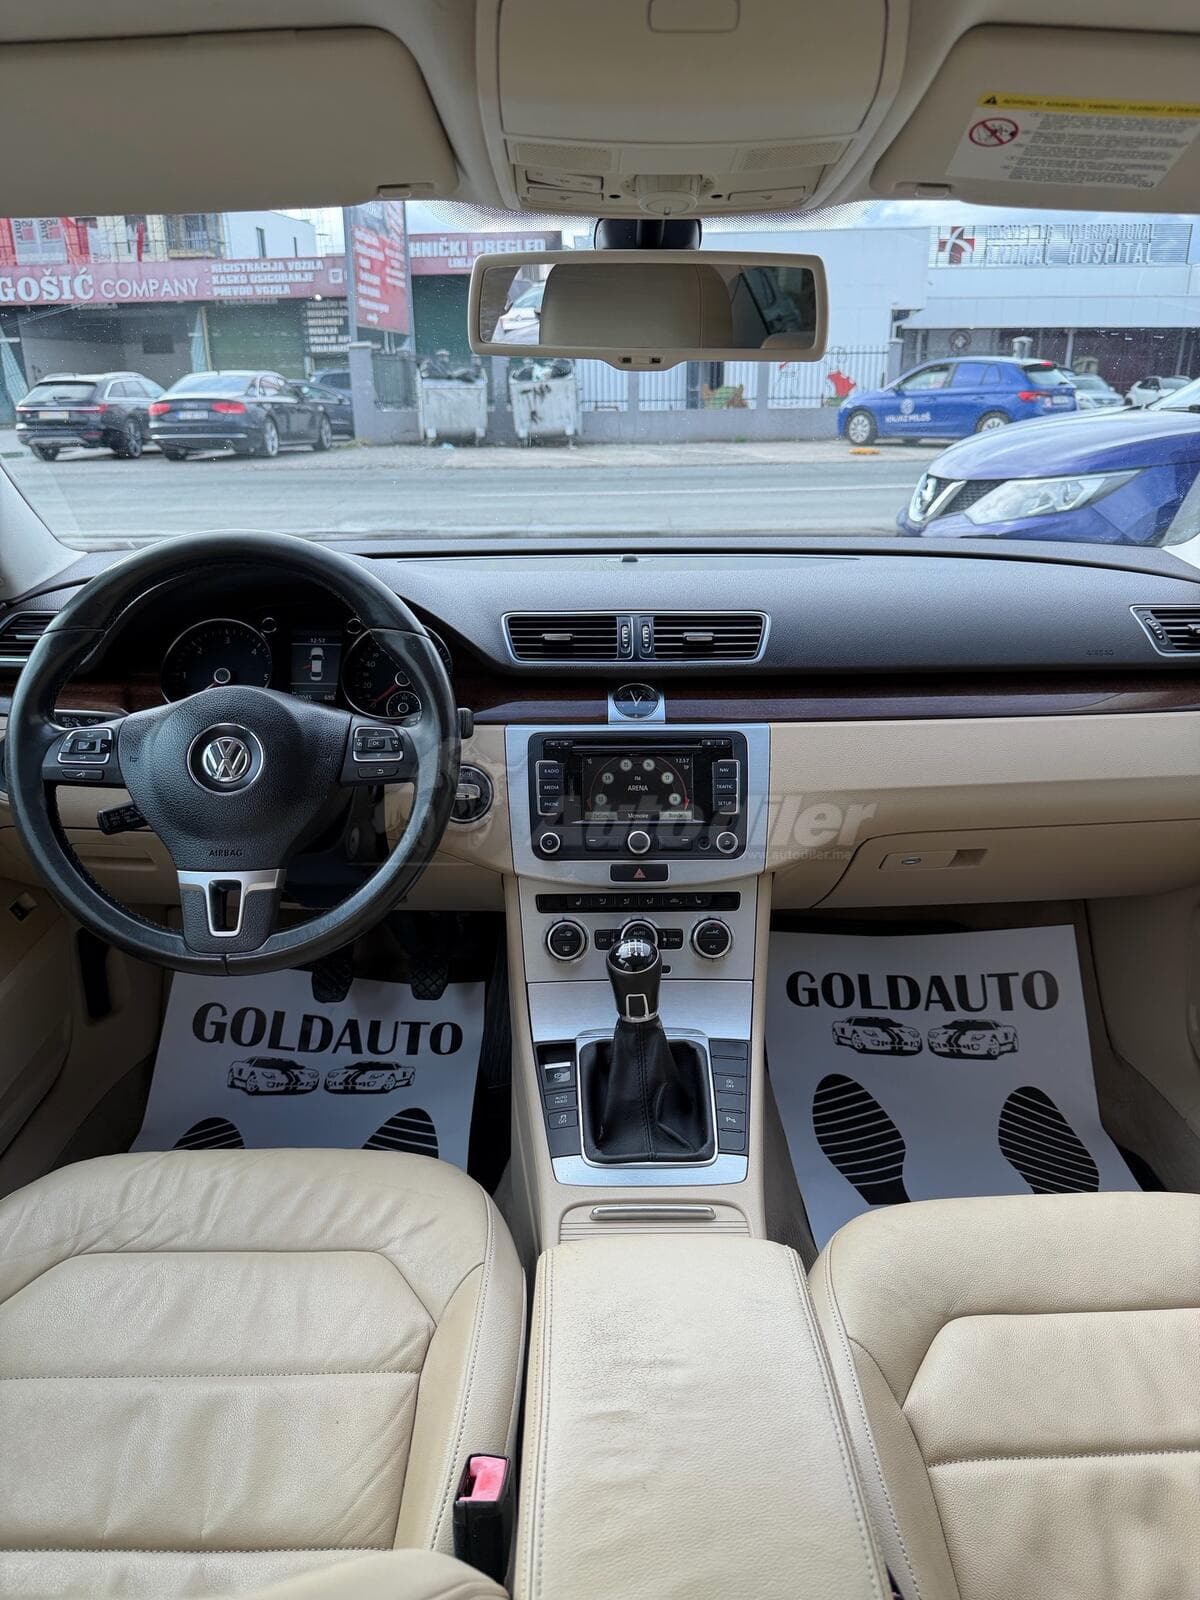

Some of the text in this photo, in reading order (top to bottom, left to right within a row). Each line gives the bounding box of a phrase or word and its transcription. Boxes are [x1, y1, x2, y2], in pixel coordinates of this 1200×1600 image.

[408, 237, 547, 257] HNIČKI PREGLED
[1066, 242, 1153, 265] HOSPITAL
[211, 260, 324, 273] REGISTRACIJA VOZILA
[0, 266, 199, 301] GOŠIĆ COMPANY
[255, 284, 291, 295] VOZILA
[209, 849, 243, 857] AIRBAG
[786, 970, 1059, 1012] GOLDAUTO
[192, 1002, 463, 1055] GOLDAUTO
